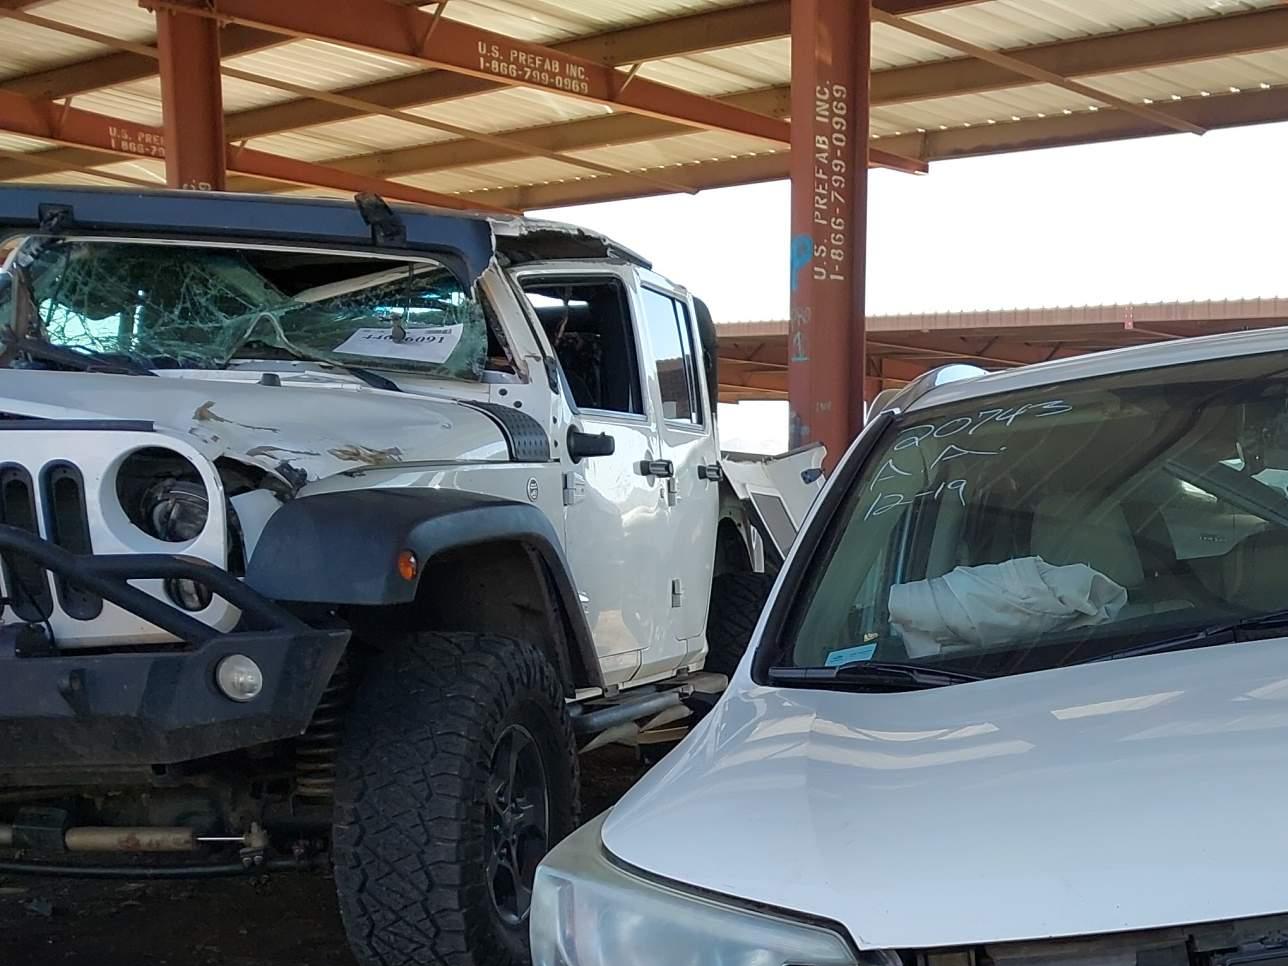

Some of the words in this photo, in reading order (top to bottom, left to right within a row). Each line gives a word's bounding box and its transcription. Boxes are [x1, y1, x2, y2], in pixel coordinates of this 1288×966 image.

[478, 41, 503, 60] U.S.
[510, 50, 559, 73] PREFAB
[566, 63, 589, 80] INC.
[480, 57, 588, 94] 1-866-799-0969
[815, 80, 830, 123] INC.
[814, 134, 829, 226] PREFAB
[830, 84, 847, 282] 1-866-799-0969
[814, 239, 827, 281] U.S.
